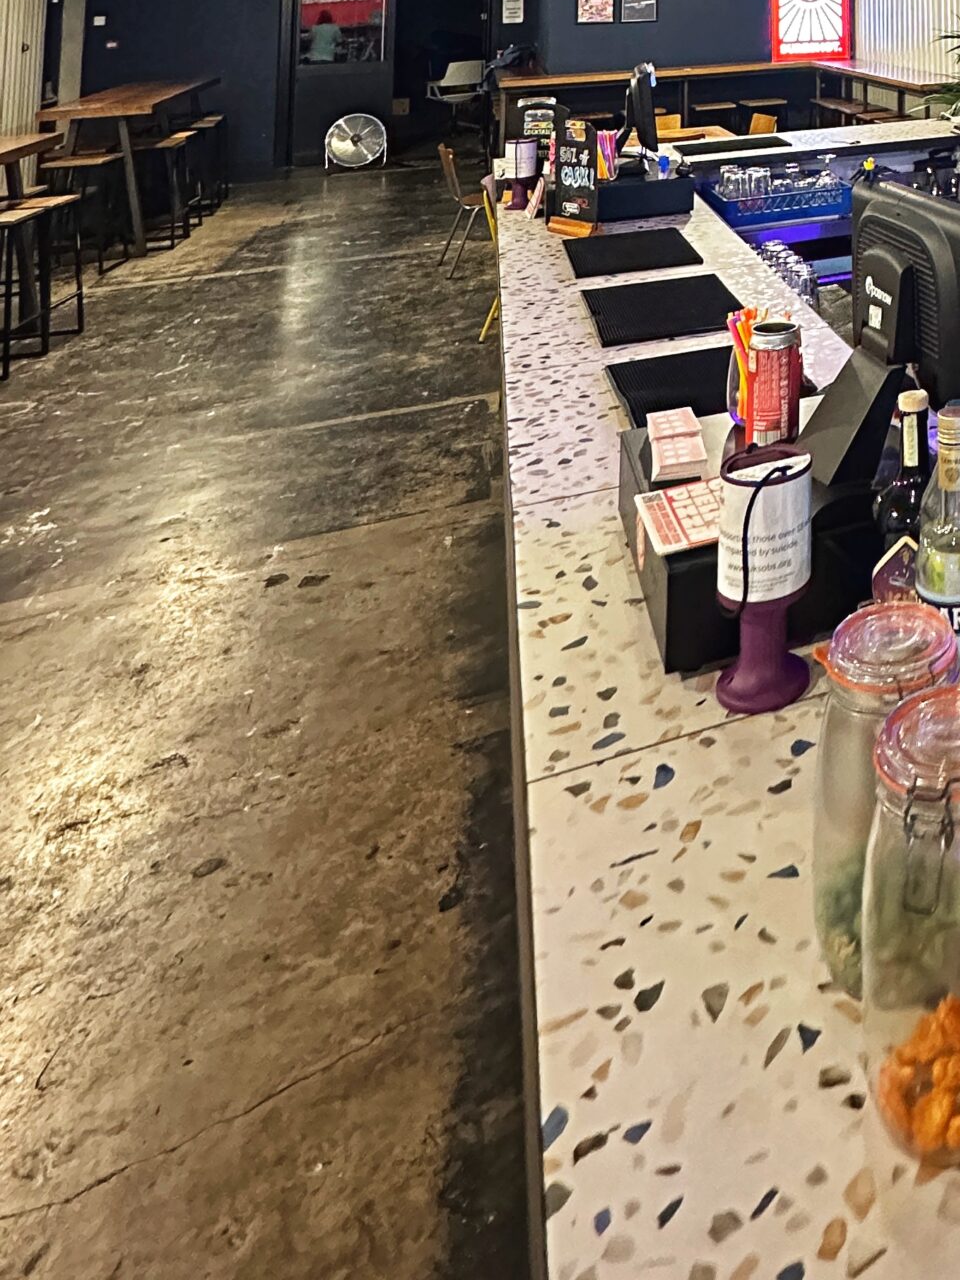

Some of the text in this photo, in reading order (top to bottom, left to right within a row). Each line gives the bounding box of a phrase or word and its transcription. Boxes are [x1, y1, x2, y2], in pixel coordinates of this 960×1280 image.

[752, 533, 776, 544] those
[759, 547, 771, 558] by
[771, 539, 799, 555] suicide
